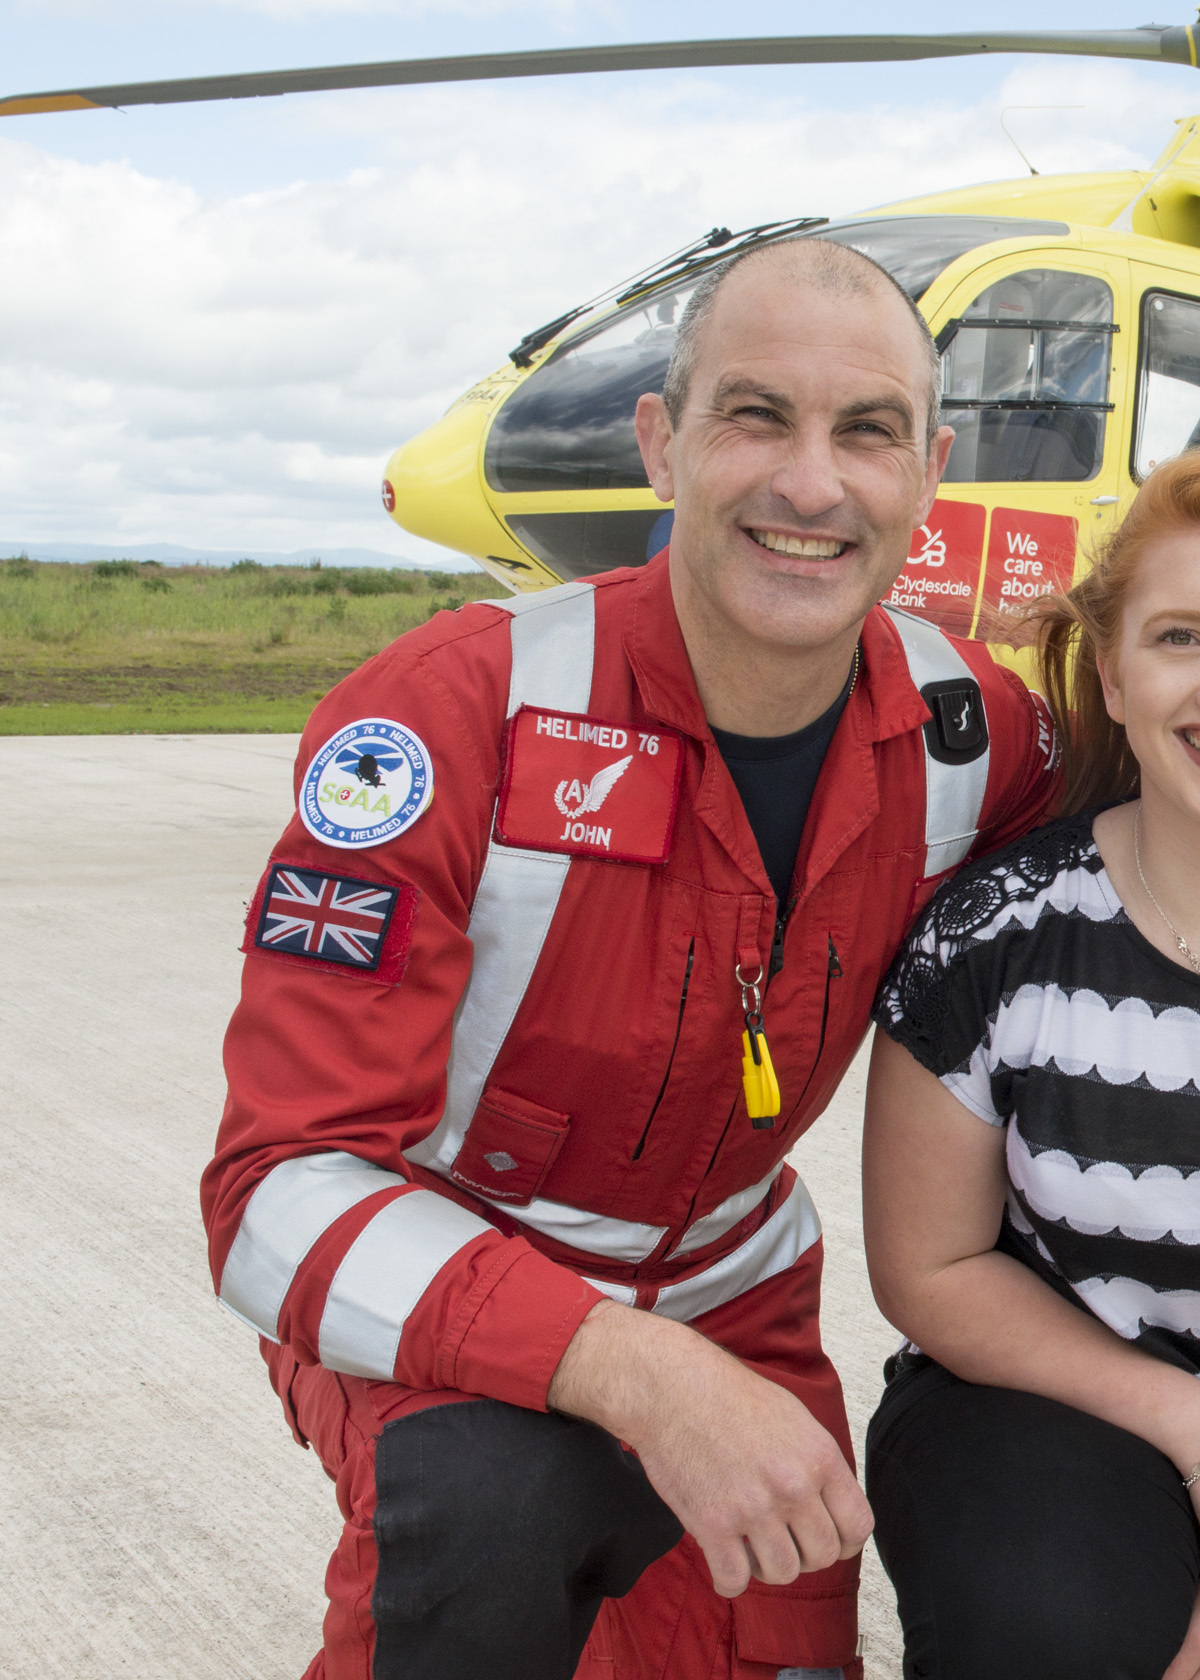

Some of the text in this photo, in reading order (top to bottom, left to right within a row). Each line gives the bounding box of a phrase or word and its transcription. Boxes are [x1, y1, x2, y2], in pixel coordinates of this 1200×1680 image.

[1006, 531, 1038, 556] We
[1004, 558, 1043, 577] care
[890, 590, 927, 608] Bank
[893, 574, 971, 597] Clydesdale
[1001, 577, 1054, 598] about
[317, 725, 376, 767] HELIMED 76
[536, 715, 660, 756] HELIMED 76
[389, 729, 425, 789] HELIMED 76
[319, 782, 391, 818] SCAA
[564, 779, 582, 803] A
[306, 781, 336, 835] HELIMED 76
[350, 803, 416, 841] HELIMED 76
[560, 821, 613, 852] JOHN
